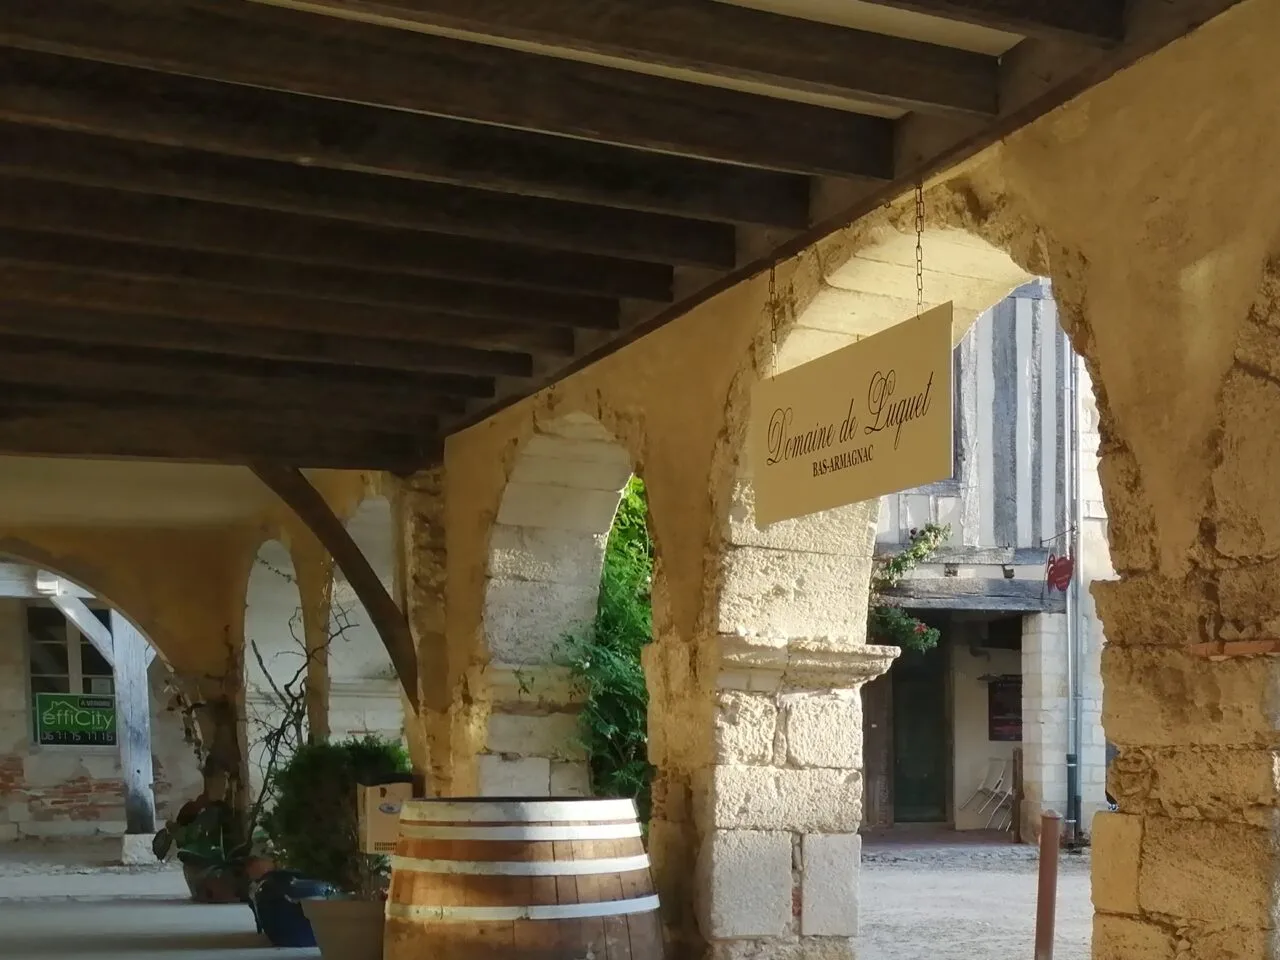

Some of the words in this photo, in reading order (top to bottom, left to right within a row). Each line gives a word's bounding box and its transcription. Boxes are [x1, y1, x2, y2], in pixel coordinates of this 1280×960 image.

[766, 407, 835, 466] Domaine
[839, 398, 858, 443] de
[864, 369, 933, 450] Luquet
[812, 444, 874, 477] BAS-ARMAGNAC
[42, 709, 114, 730] effiCity
